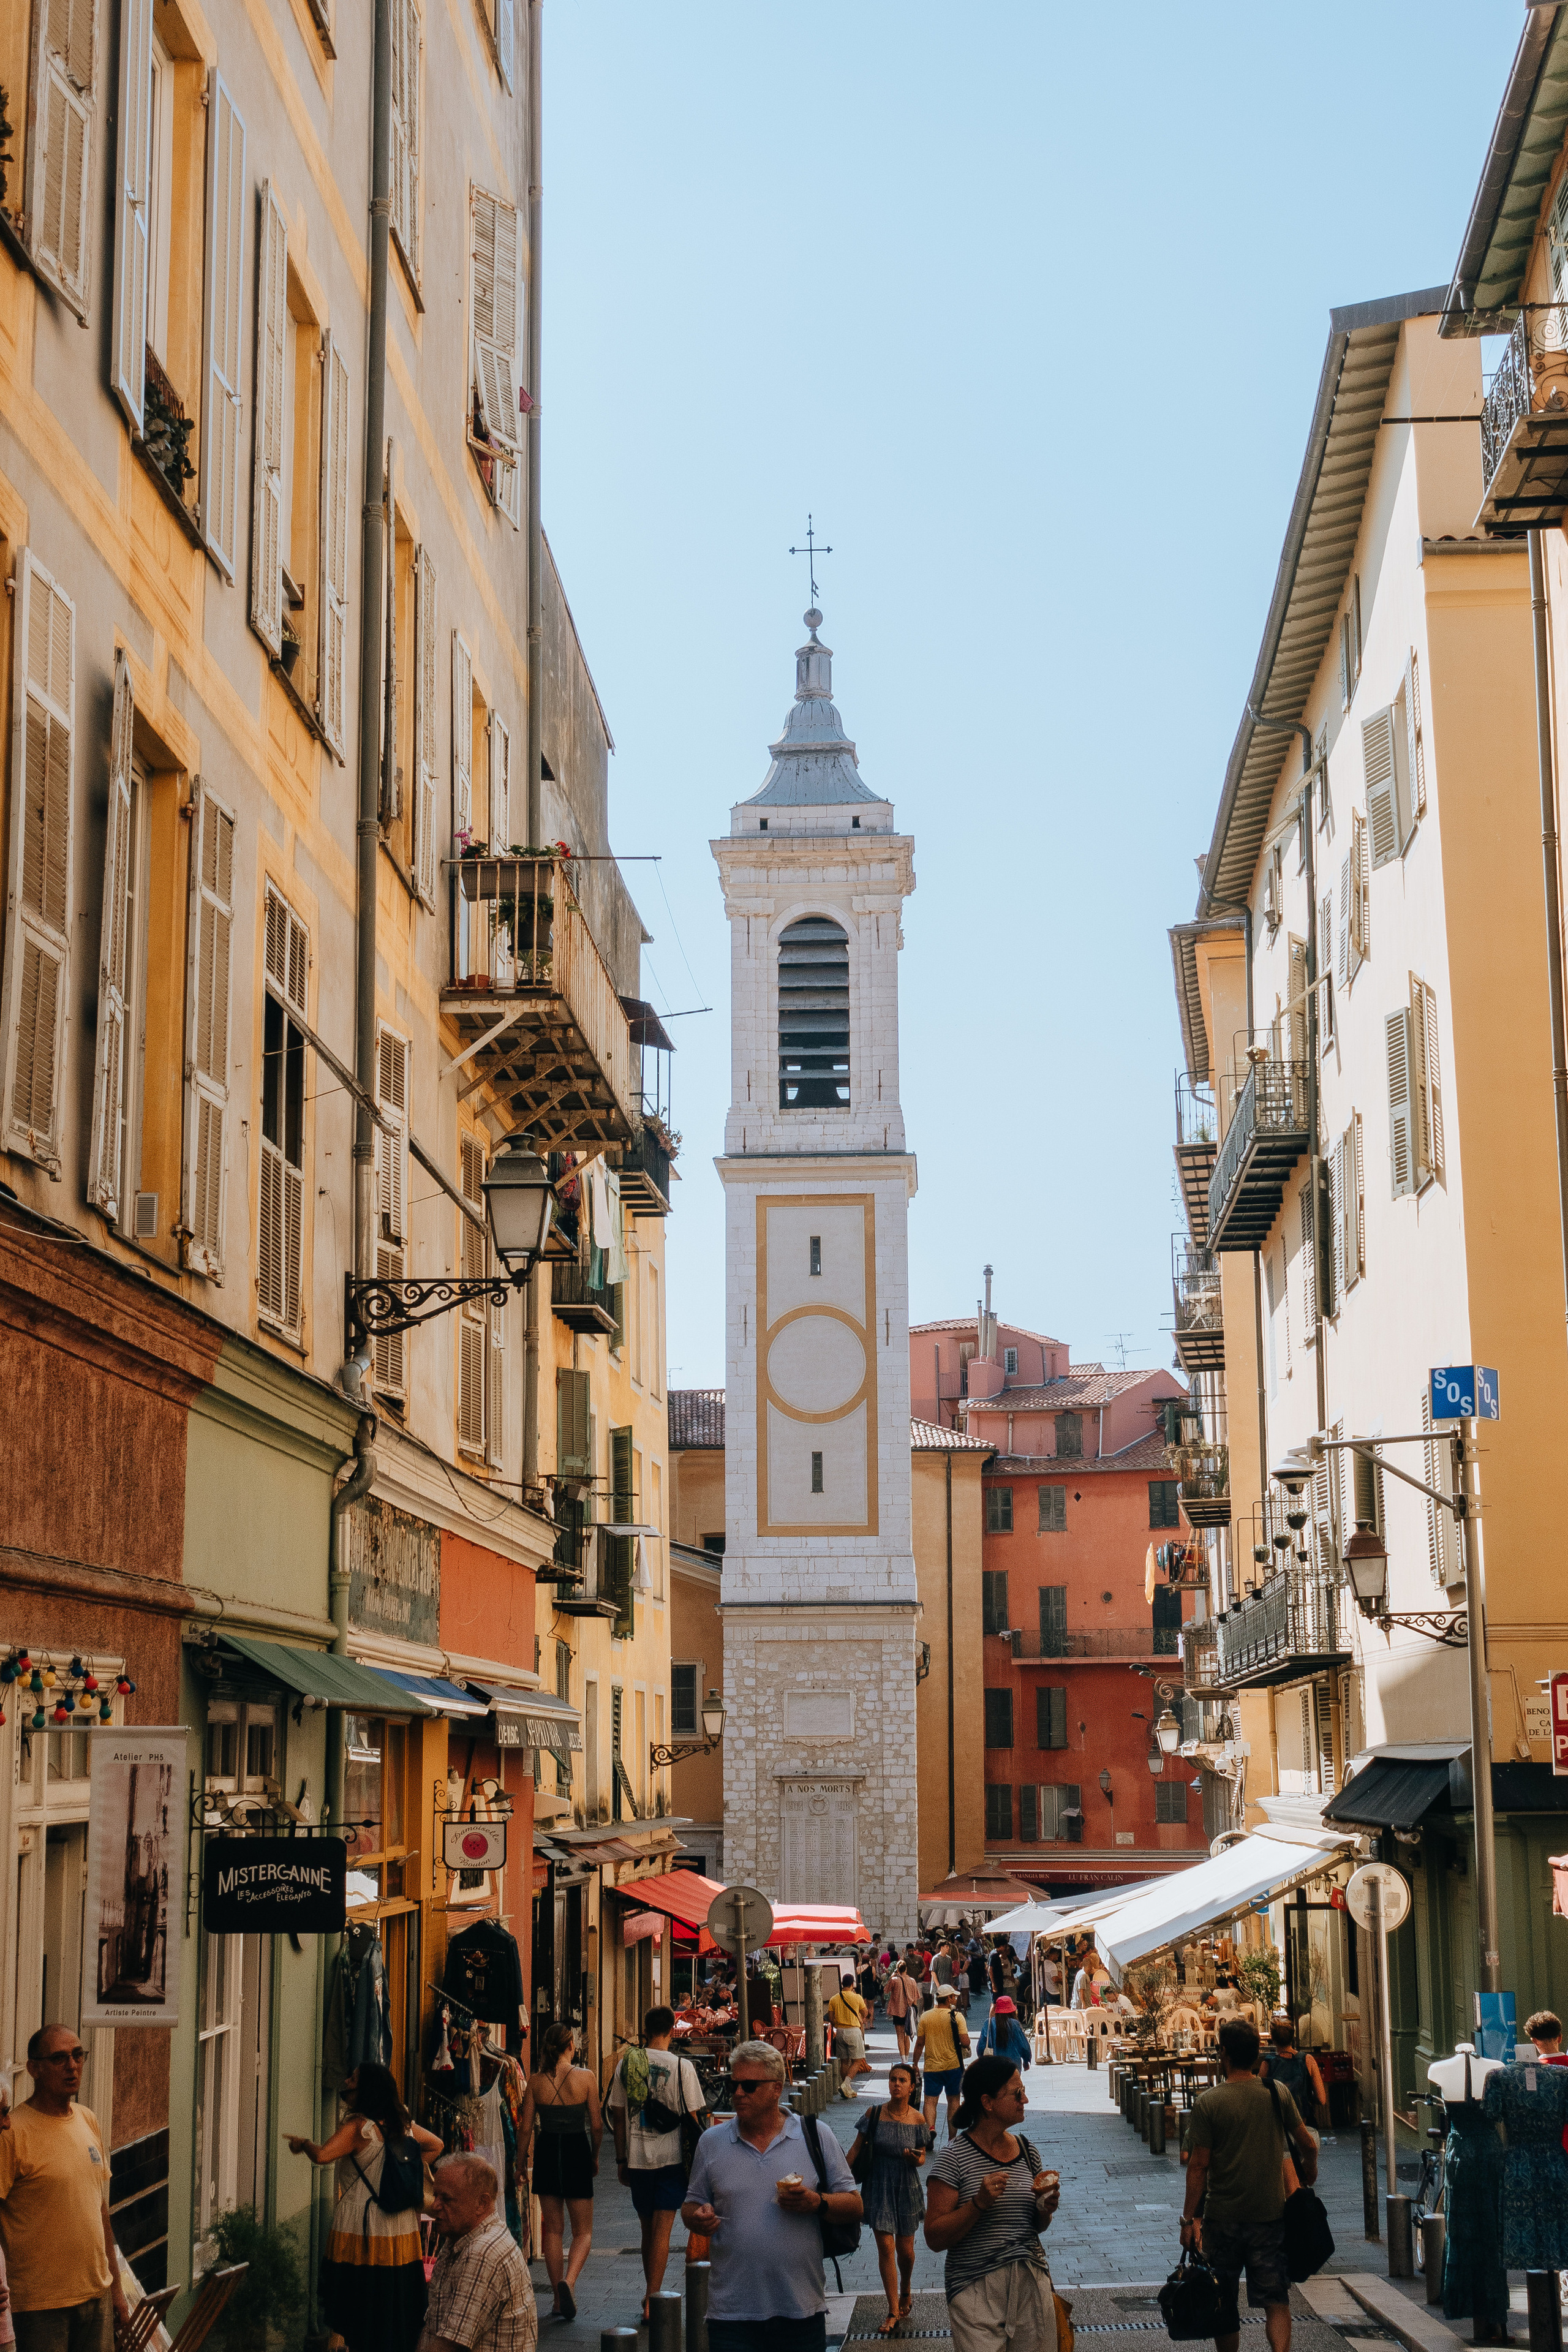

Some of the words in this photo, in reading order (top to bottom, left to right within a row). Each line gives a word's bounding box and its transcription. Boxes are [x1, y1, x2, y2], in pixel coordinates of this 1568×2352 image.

[1434, 1369, 1473, 1416] SOS
[1478, 1367, 1498, 1419] SOS
[238, 1890, 251, 1900] LES
[247, 1883, 293, 1902] ACCESSOIRES
[277, 1890, 311, 1902] ELEGANTS
